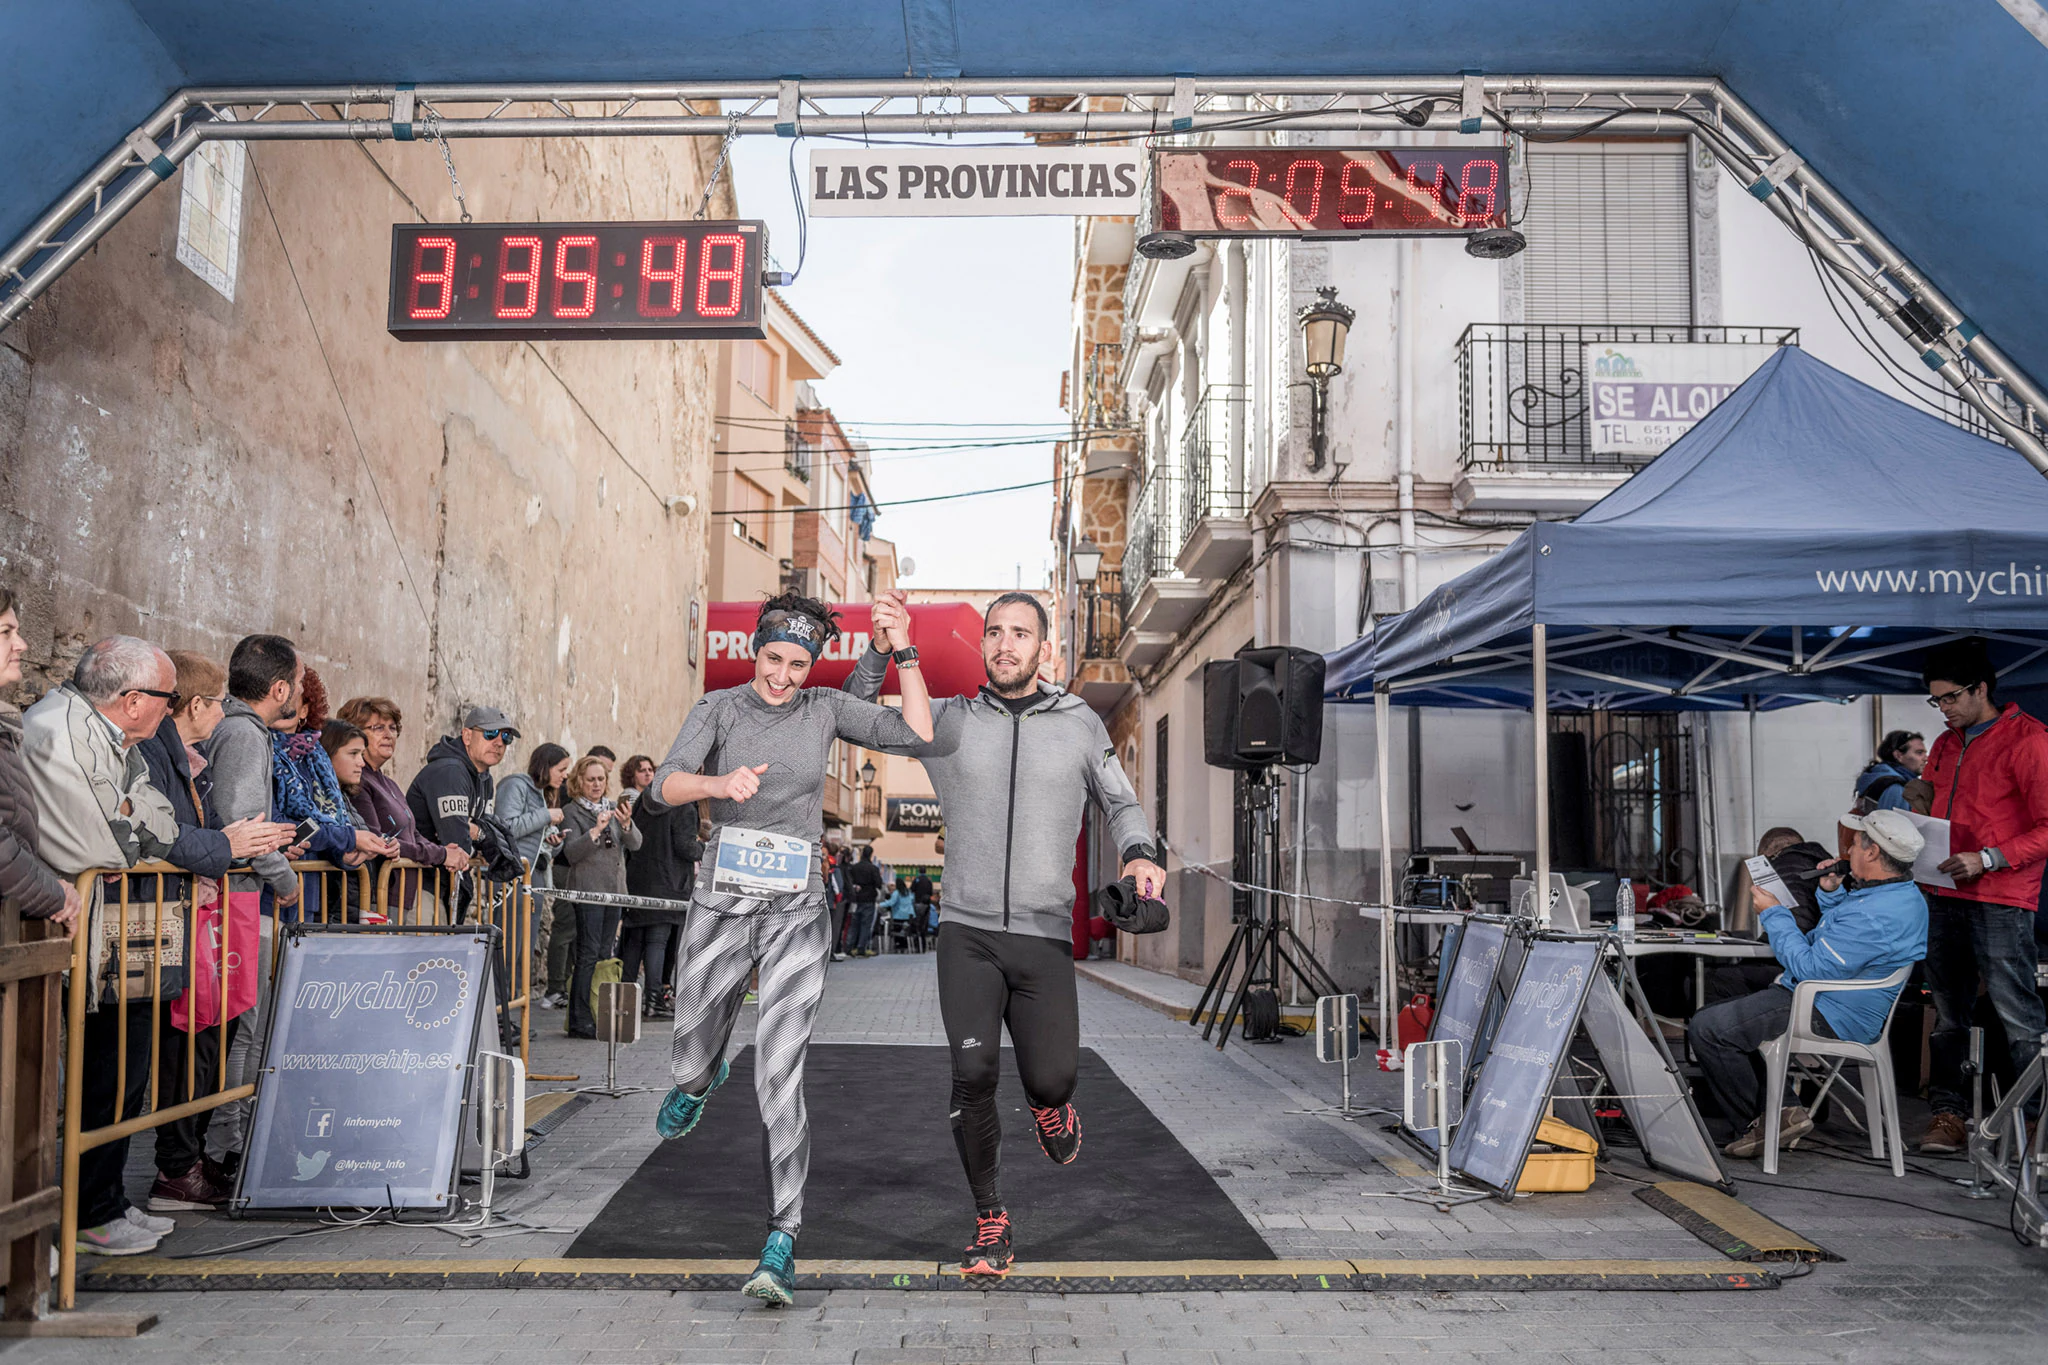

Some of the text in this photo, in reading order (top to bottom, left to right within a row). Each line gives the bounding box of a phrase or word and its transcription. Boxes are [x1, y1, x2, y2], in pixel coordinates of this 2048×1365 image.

[815, 163, 1137, 200] LAS PROVINCIAS
[1599, 385, 1736, 420] SE ALQU
[1815, 562, 2048, 604] www.mychi
[441, 799, 468, 813] CORE
[899, 803, 942, 816] POW
[736, 849, 788, 872] 1021
[295, 970, 438, 1018] mychip
[282, 1049, 452, 1074] www.mychip.es
[334, 1158, 406, 1173] @Mychip_Info
